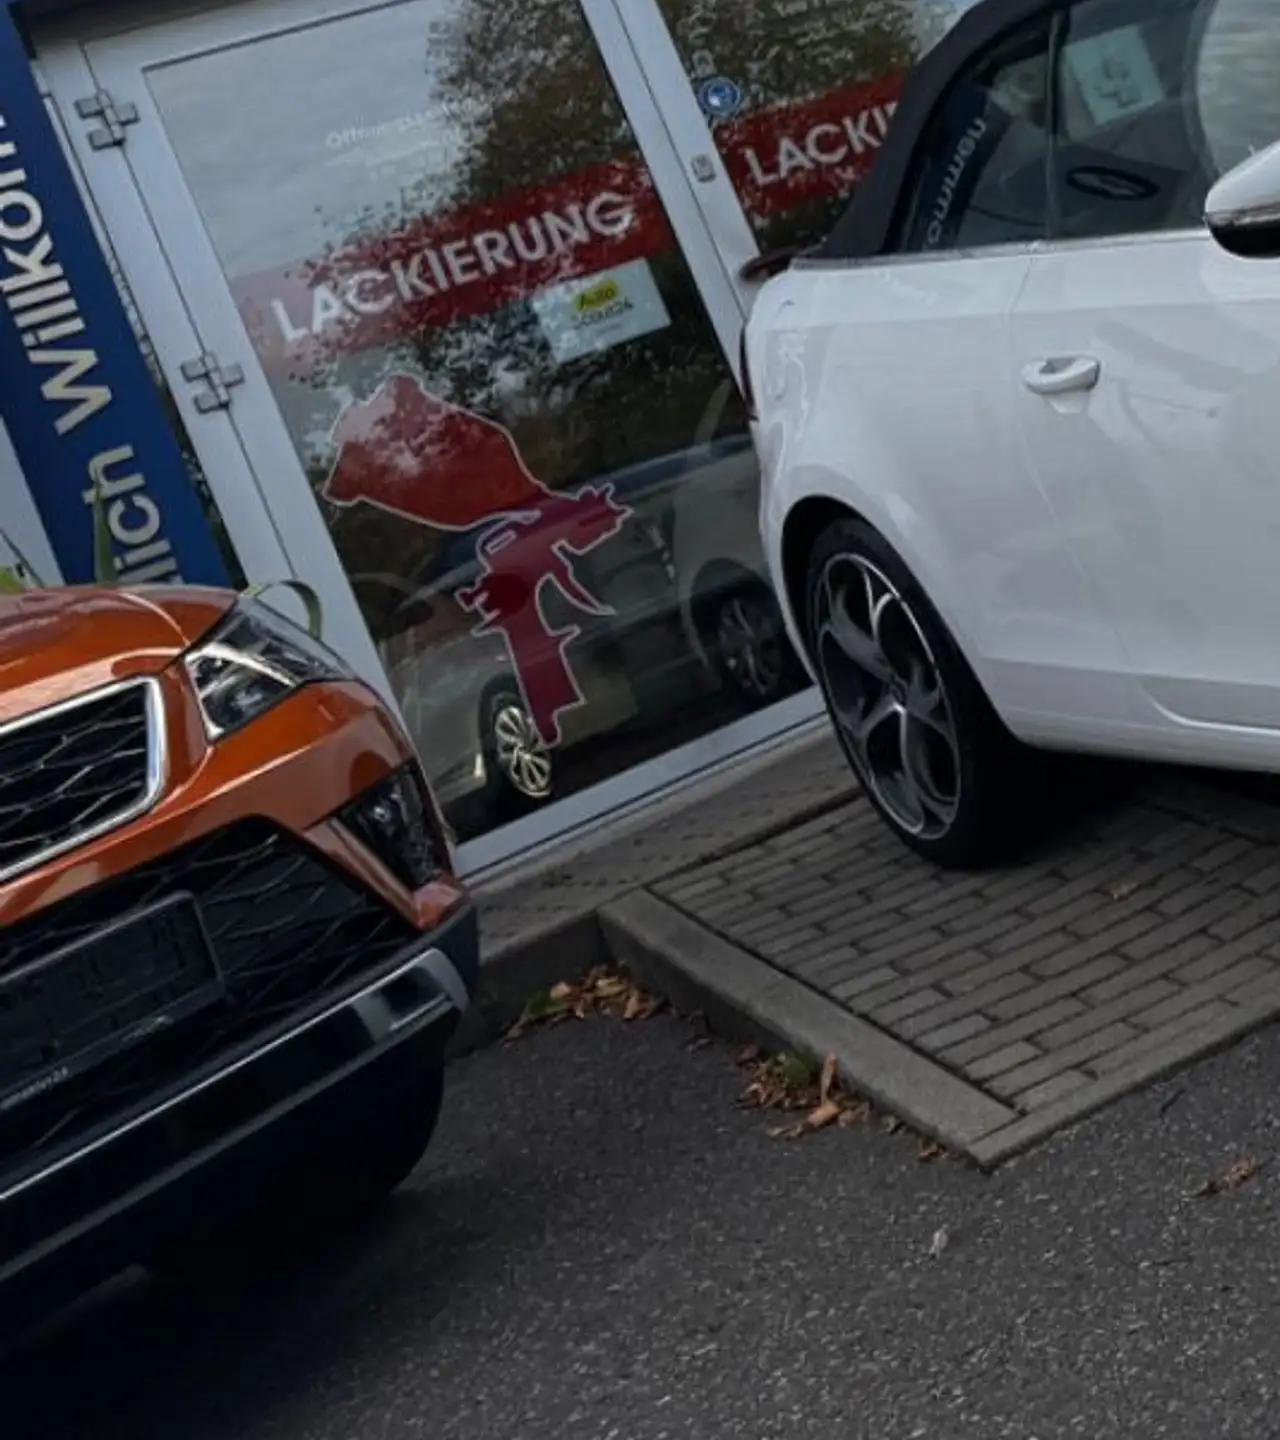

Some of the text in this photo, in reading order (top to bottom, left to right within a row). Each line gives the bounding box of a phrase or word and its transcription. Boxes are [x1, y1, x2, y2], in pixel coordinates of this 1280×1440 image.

[744, 101, 899, 187] LACKI
[271, 191, 637, 342] LACKIERUNG
[81, 444, 184, 584] lich
